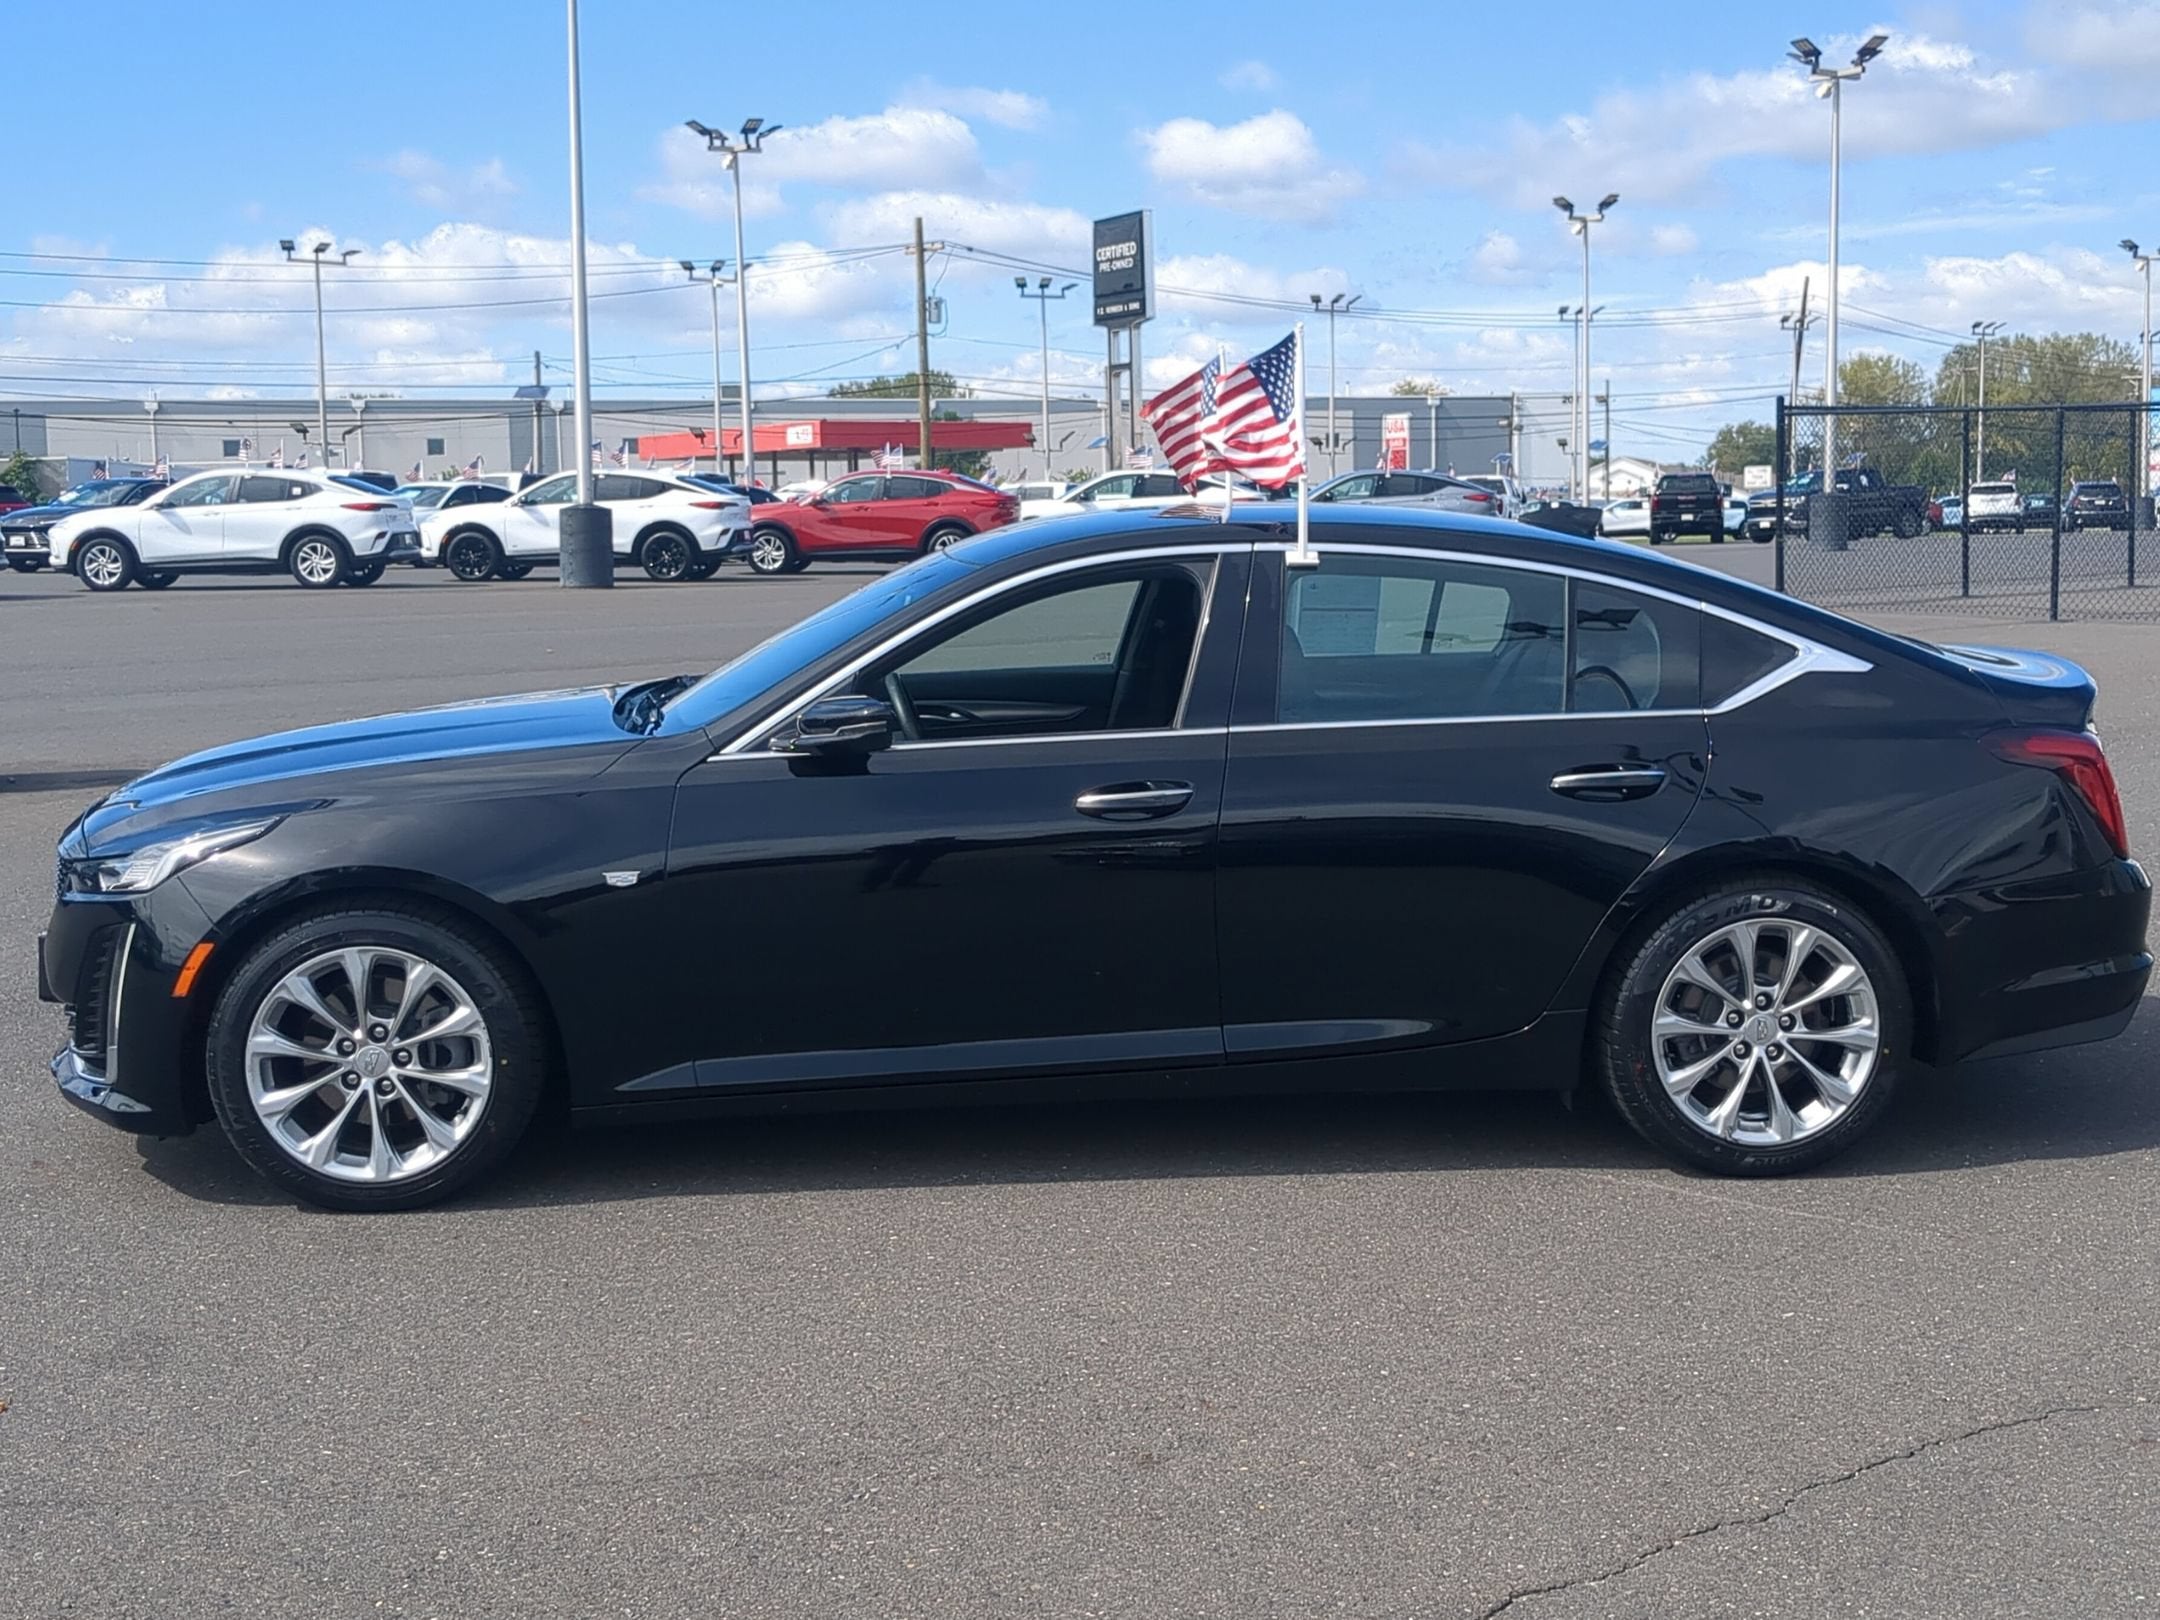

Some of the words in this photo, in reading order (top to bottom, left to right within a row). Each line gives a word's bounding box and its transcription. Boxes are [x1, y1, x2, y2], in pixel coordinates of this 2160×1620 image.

[1096, 241, 1137, 262] CERTIFIED
[1099, 257, 1134, 273] PRE-OWNED
[1387, 419, 1405, 434] USA
